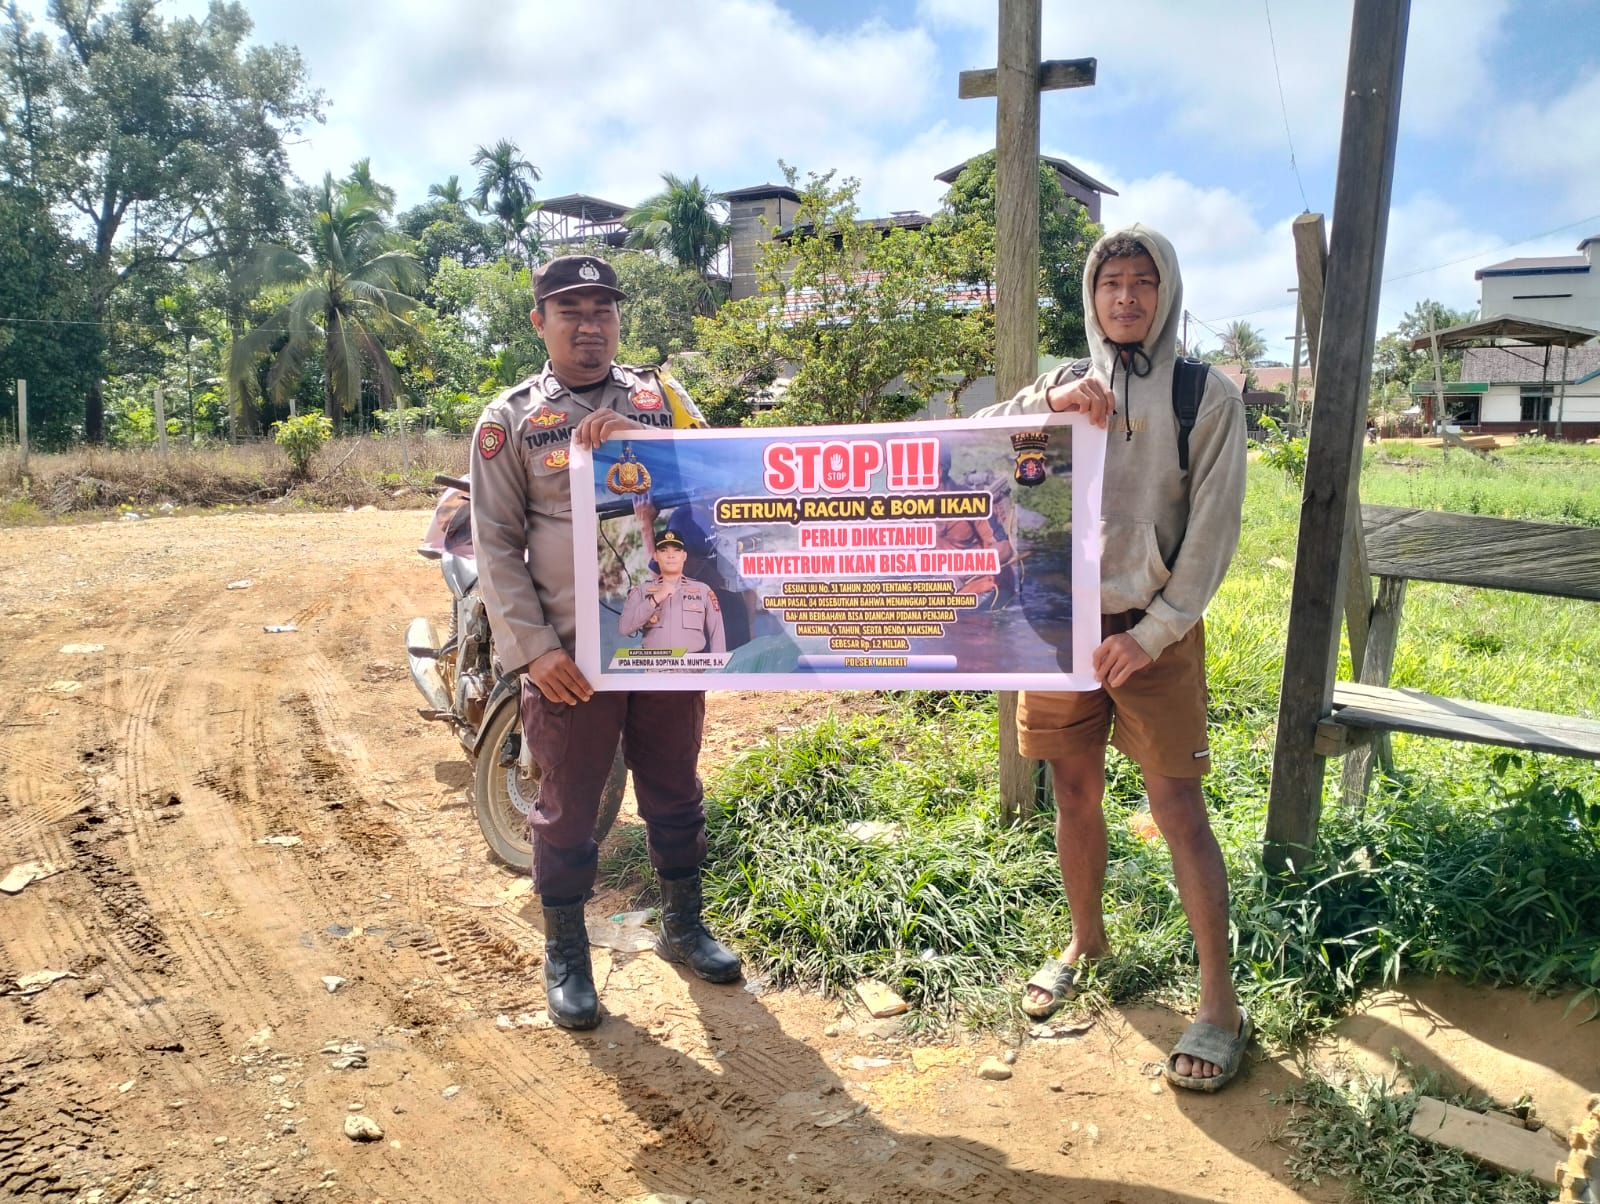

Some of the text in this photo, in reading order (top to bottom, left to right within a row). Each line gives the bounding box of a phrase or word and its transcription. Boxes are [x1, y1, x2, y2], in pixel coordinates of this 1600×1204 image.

[768, 444, 880, 490] STOP
[827, 472, 847, 481] STOP
[720, 497, 986, 520] SETRUM, RACUN & BOM IKAN
[801, 527, 933, 547] PERLU DIKETAHUI
[743, 552, 997, 574] MENYETRUM IKAN BISA DIPIDANA
[784, 584, 807, 593] SESUAI
[808, 584, 817, 593] UU
[819, 583, 829, 593] No.
[831, 583, 838, 592] 31
[839, 583, 861, 592] TAHUN
[863, 582, 880, 592] 2009
[882, 582, 911, 592] TENTANG
[765, 598, 787, 607] DALAM
[788, 598, 807, 607] PASAL
[819, 598, 859, 607] DISEBUTKAN
[860, 597, 884, 606] BAHWA
[886, 597, 927, 606] MENANGKAP
[928, 597, 945, 606] IKAN
[947, 596, 975, 606] DENGAN
[809, 611, 846, 620] BERBAHAYA
[848, 611, 863, 620] BISA
[865, 611, 895, 620] DIANCAM
[896, 611, 921, 620] PIDANA
[923, 611, 954, 620] PENJARA
[798, 625, 830, 634] MAKSIMAL
[832, 625, 837, 634] 6
[862, 625, 882, 634] SERTA
[883, 625, 905, 634] DENDA
[907, 625, 942, 634] MAKSIMAL
[831, 639, 859, 648] SEBESAR
[631, 659, 654, 667] HENDRA
[655, 659, 679, 667] SOPIYAN
[845, 657, 907, 667] POLSEK MARIKIT
